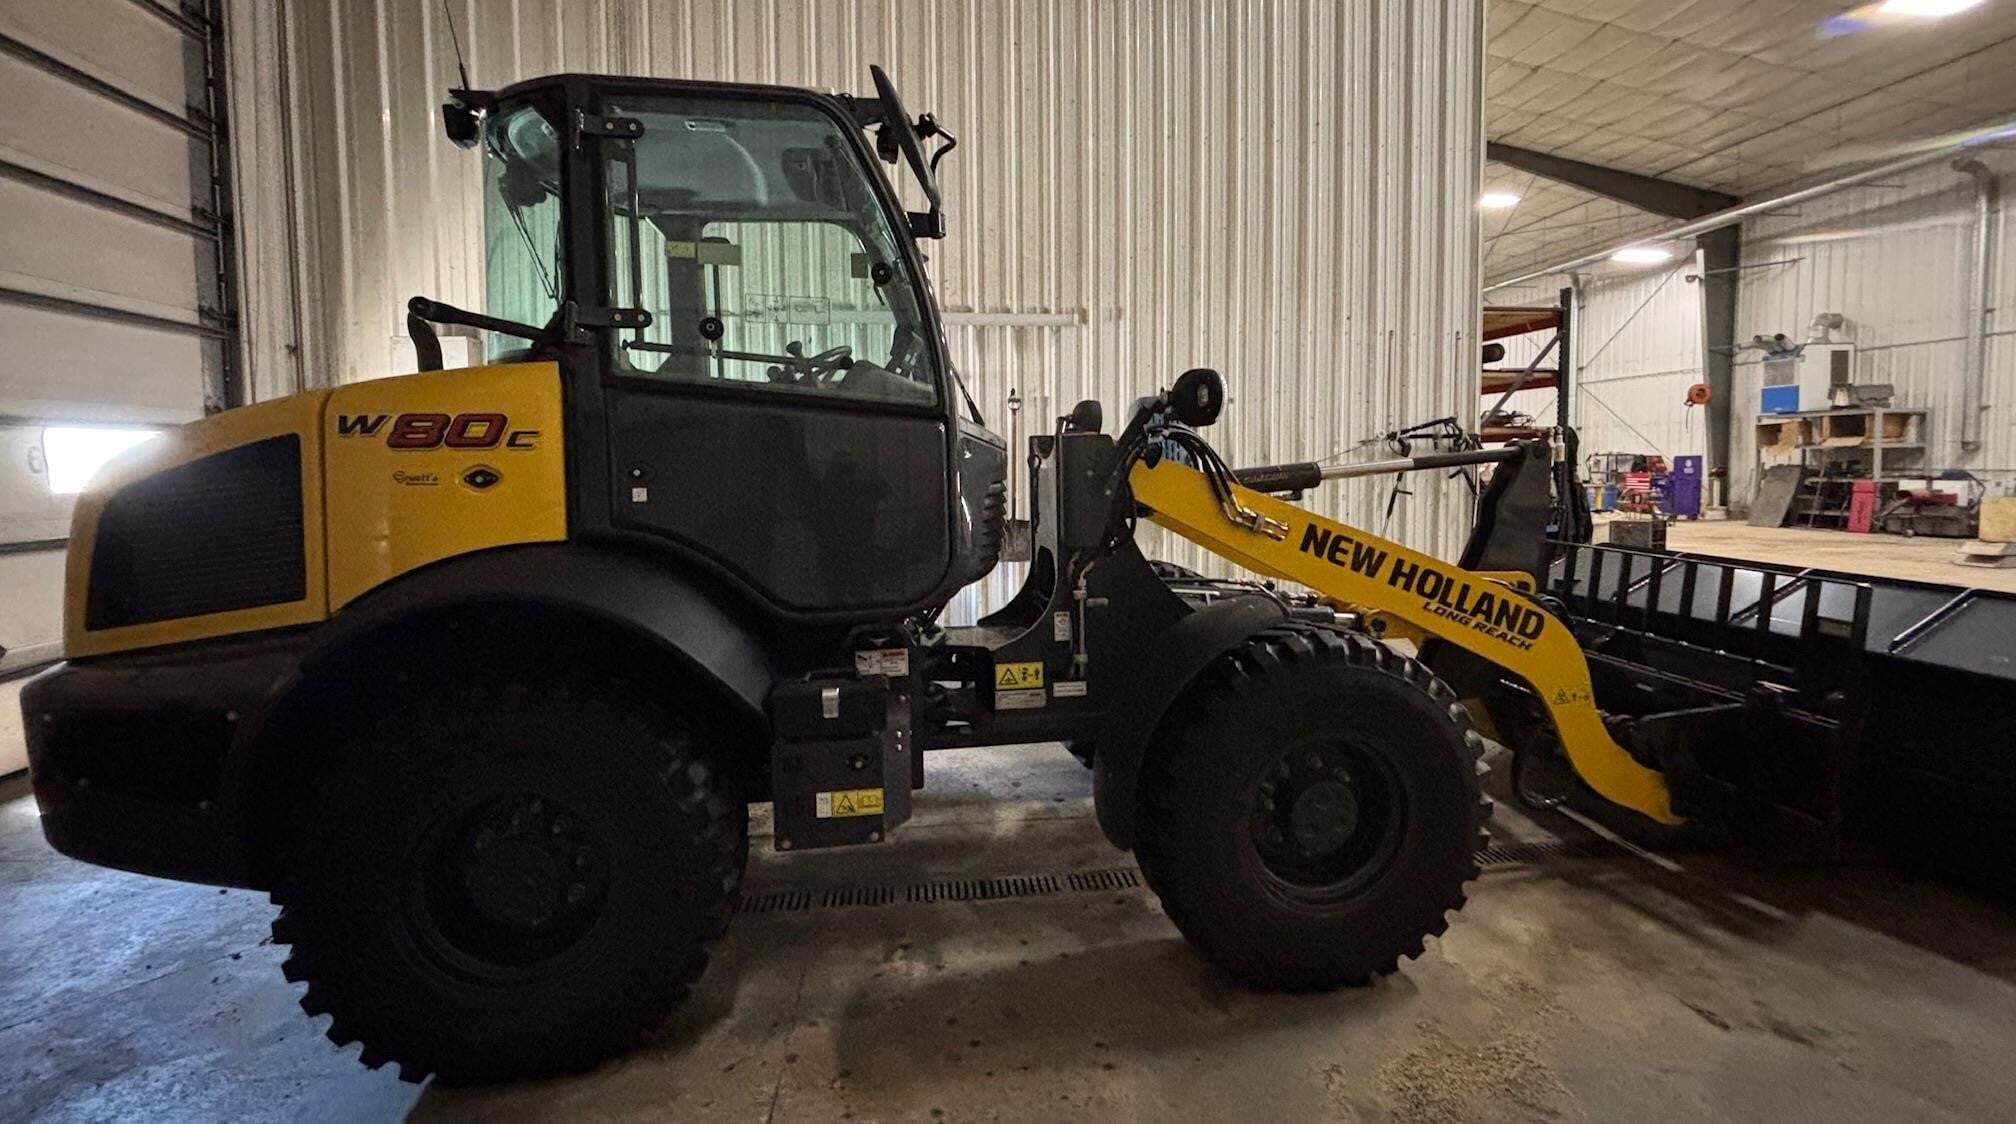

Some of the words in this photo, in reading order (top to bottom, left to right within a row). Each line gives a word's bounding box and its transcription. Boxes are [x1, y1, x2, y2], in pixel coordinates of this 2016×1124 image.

[1299, 522, 1388, 579] NEW
[1387, 558, 1545, 641] HOLLAND
[1422, 601, 1471, 626] LONG
[1472, 618, 1534, 651] REACH
